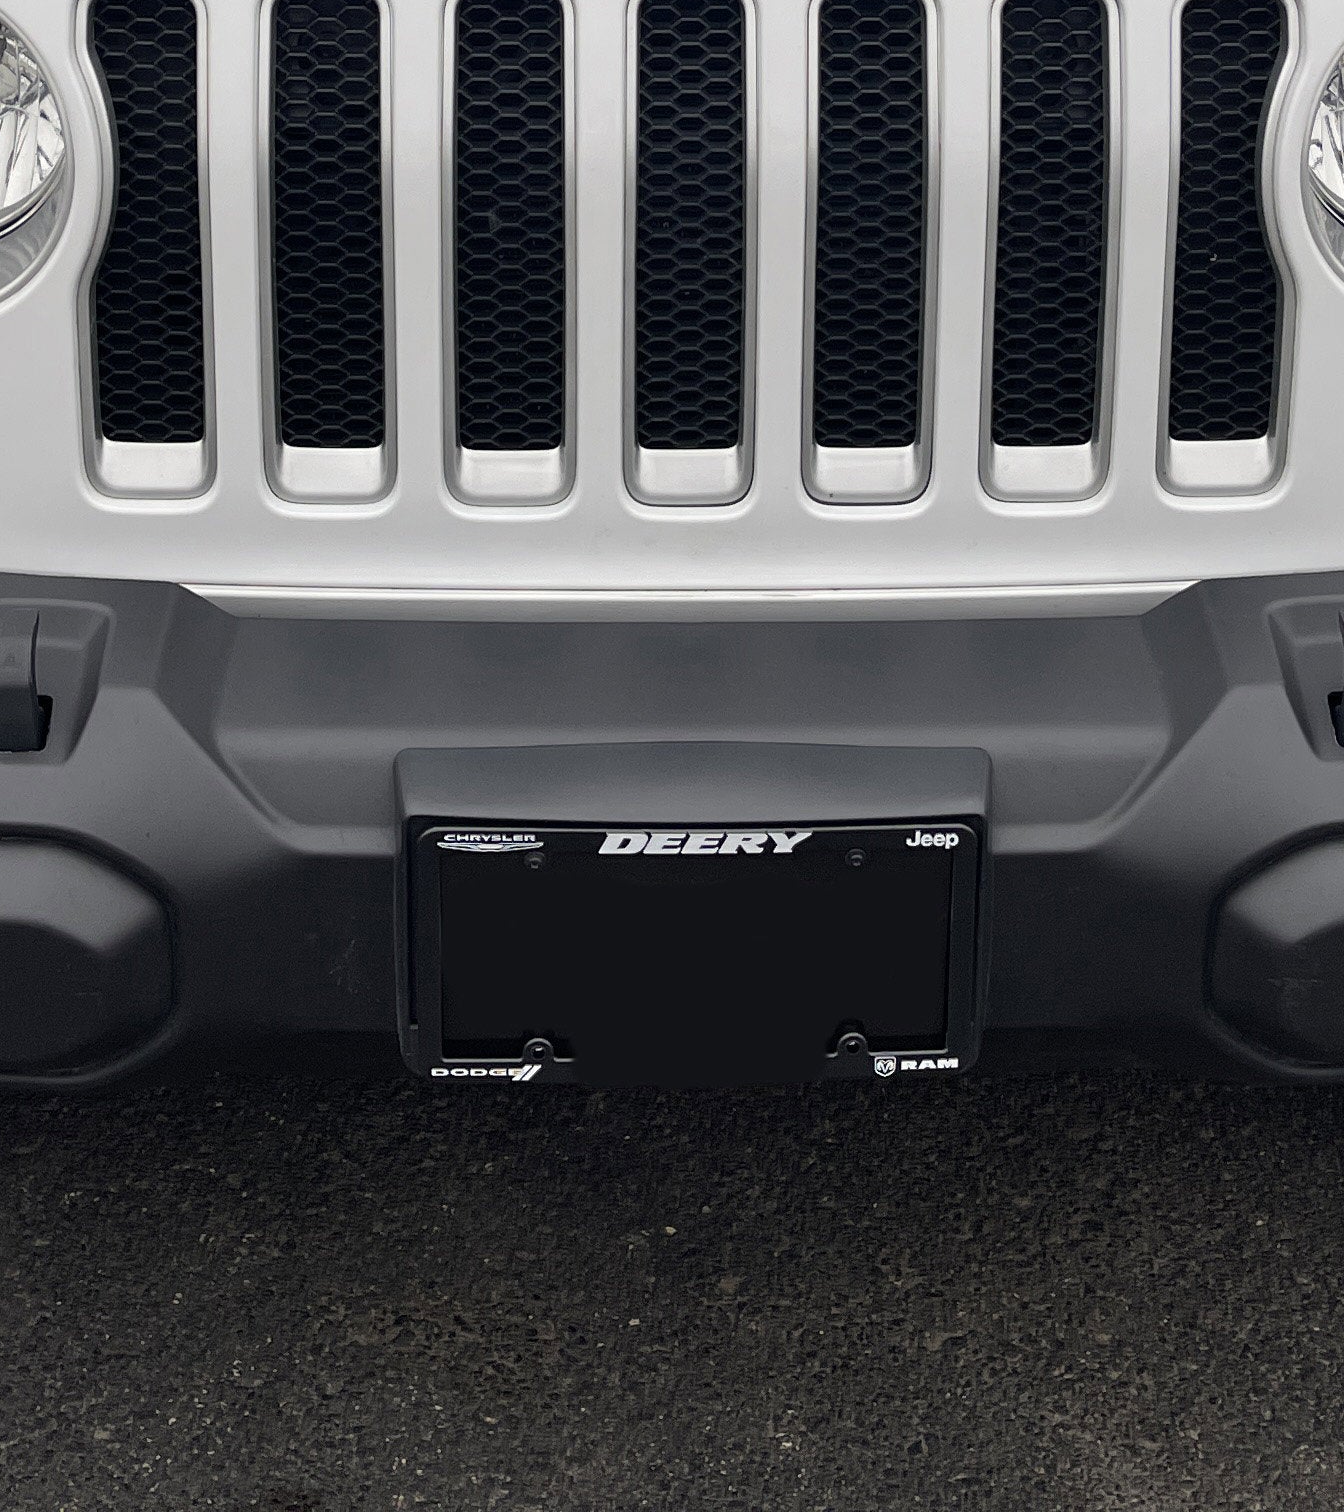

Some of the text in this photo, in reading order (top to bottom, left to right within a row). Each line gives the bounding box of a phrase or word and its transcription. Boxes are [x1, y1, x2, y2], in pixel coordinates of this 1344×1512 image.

[443, 833, 536, 842] CHRYSLER
[598, 832, 813, 854] DEERY
[905, 830, 959, 849] Jeep
[900, 1058, 959, 1070] RAM
[431, 1068, 523, 1076] DODGE
